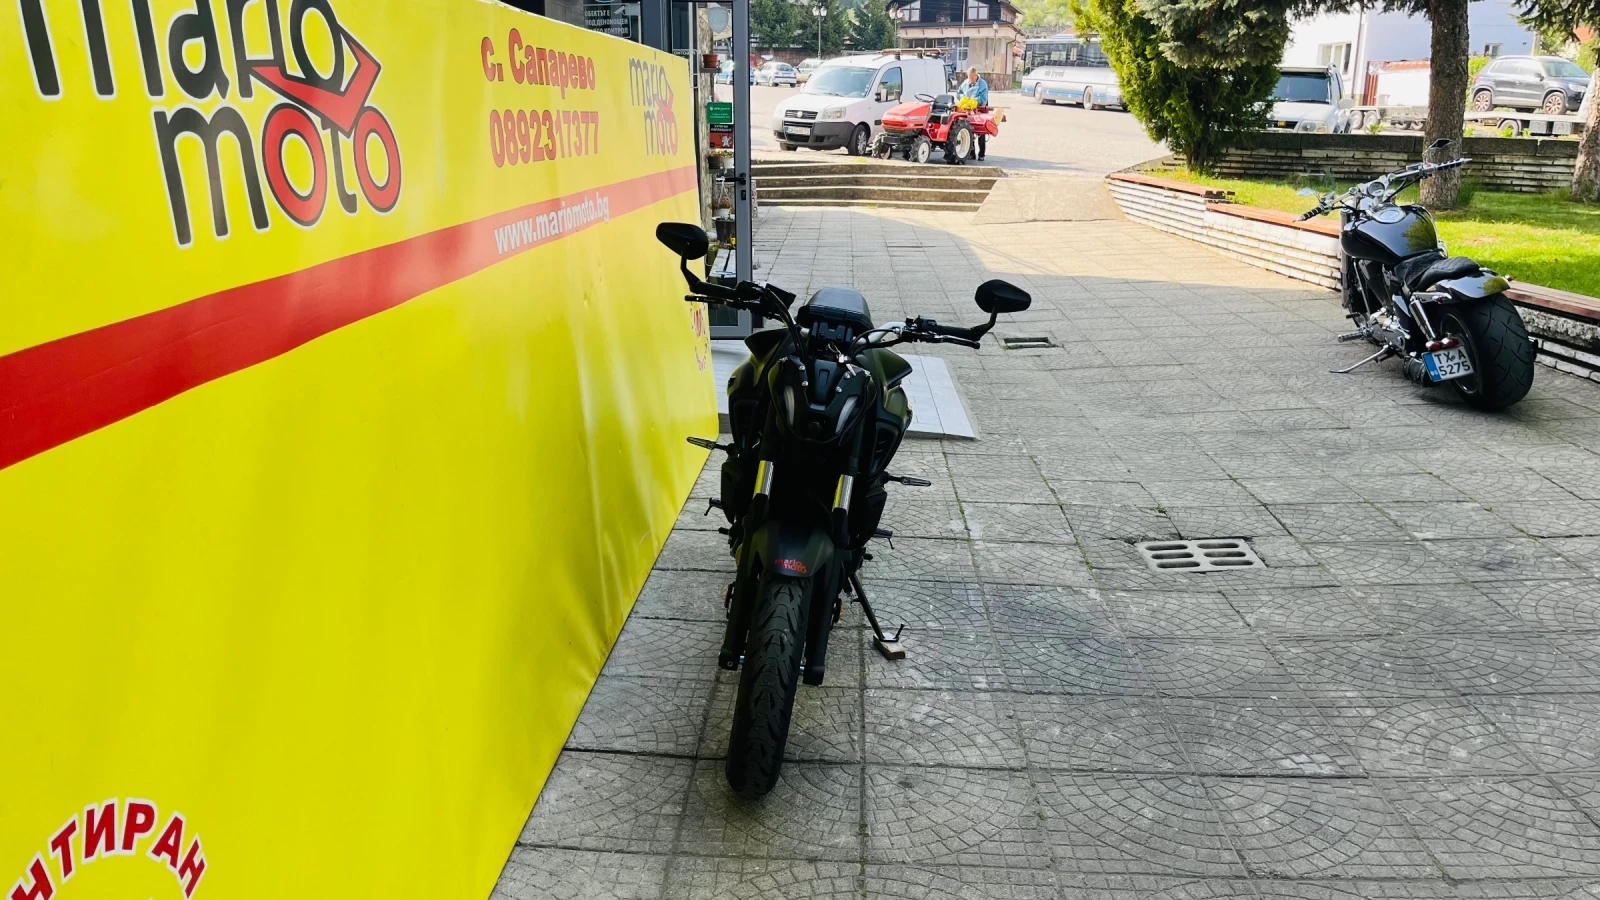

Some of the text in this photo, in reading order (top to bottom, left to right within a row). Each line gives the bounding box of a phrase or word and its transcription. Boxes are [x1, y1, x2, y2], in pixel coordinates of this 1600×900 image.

[481, 28, 596, 99] с. Сапарево
[628, 51, 668, 107] mario
[490, 109, 599, 168] 0892317377
[644, 110, 678, 156] moto
[153, 102, 401, 246] moto
[493, 191, 610, 256] www.mariomoto.bg
[1439, 361, 1470, 375] 5275
